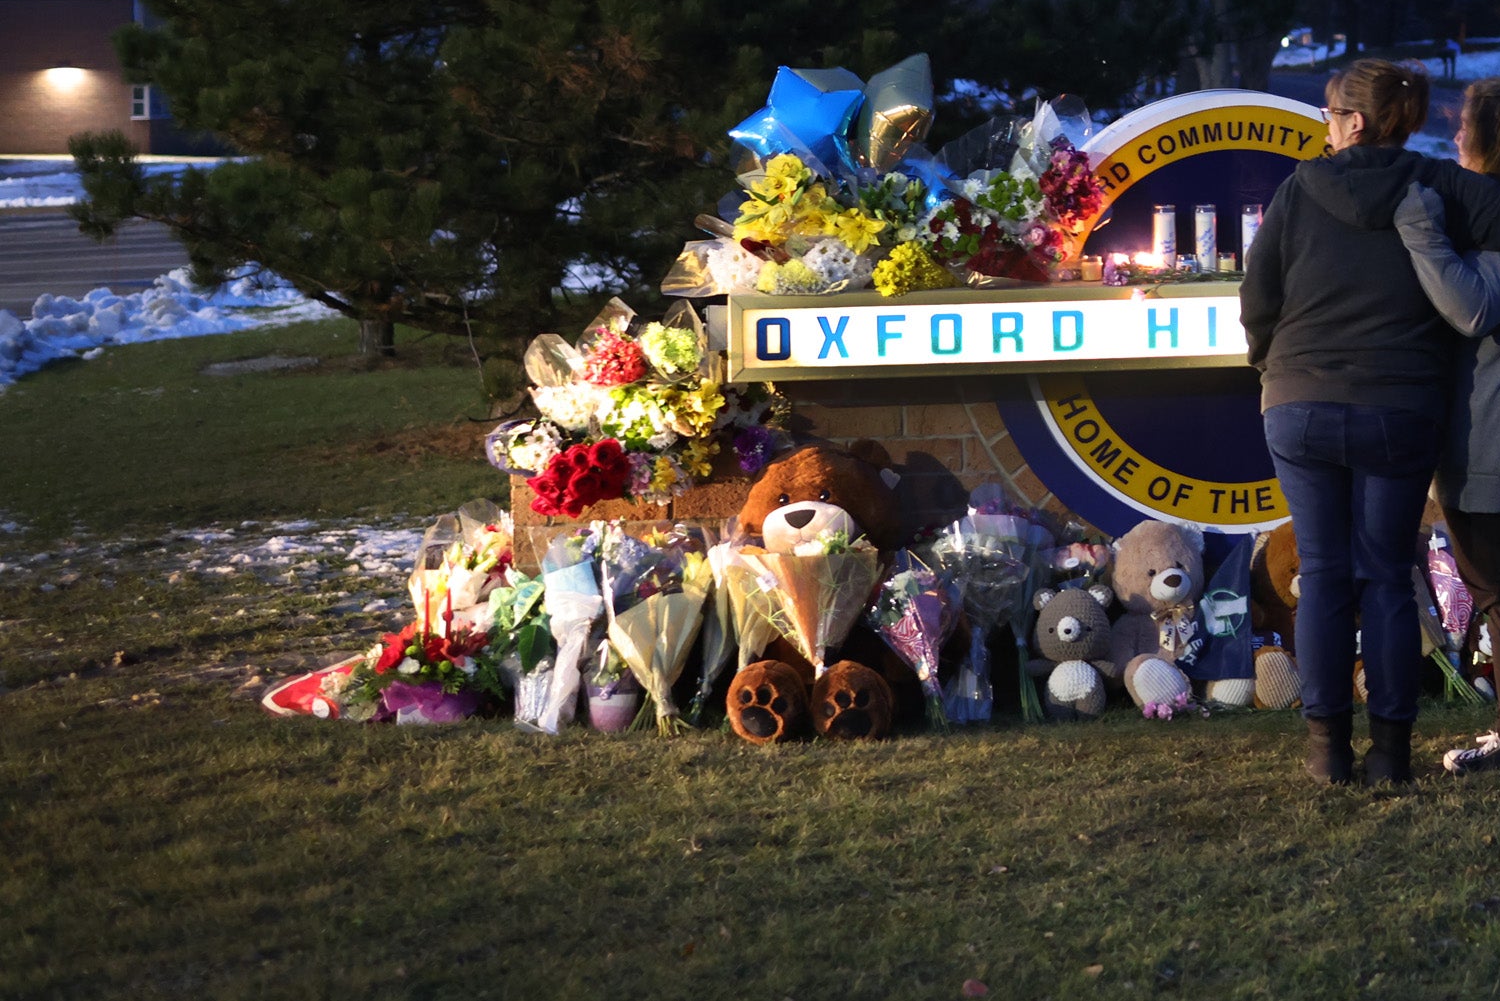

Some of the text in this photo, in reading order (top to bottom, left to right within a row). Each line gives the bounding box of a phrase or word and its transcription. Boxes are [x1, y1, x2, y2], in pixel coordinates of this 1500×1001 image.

[1137, 121, 1313, 165] COMMUNITY
[756, 310, 1085, 361] OXFORD
[1147, 306, 1217, 349] HI
[1057, 393, 1275, 514] HOME OF THE
